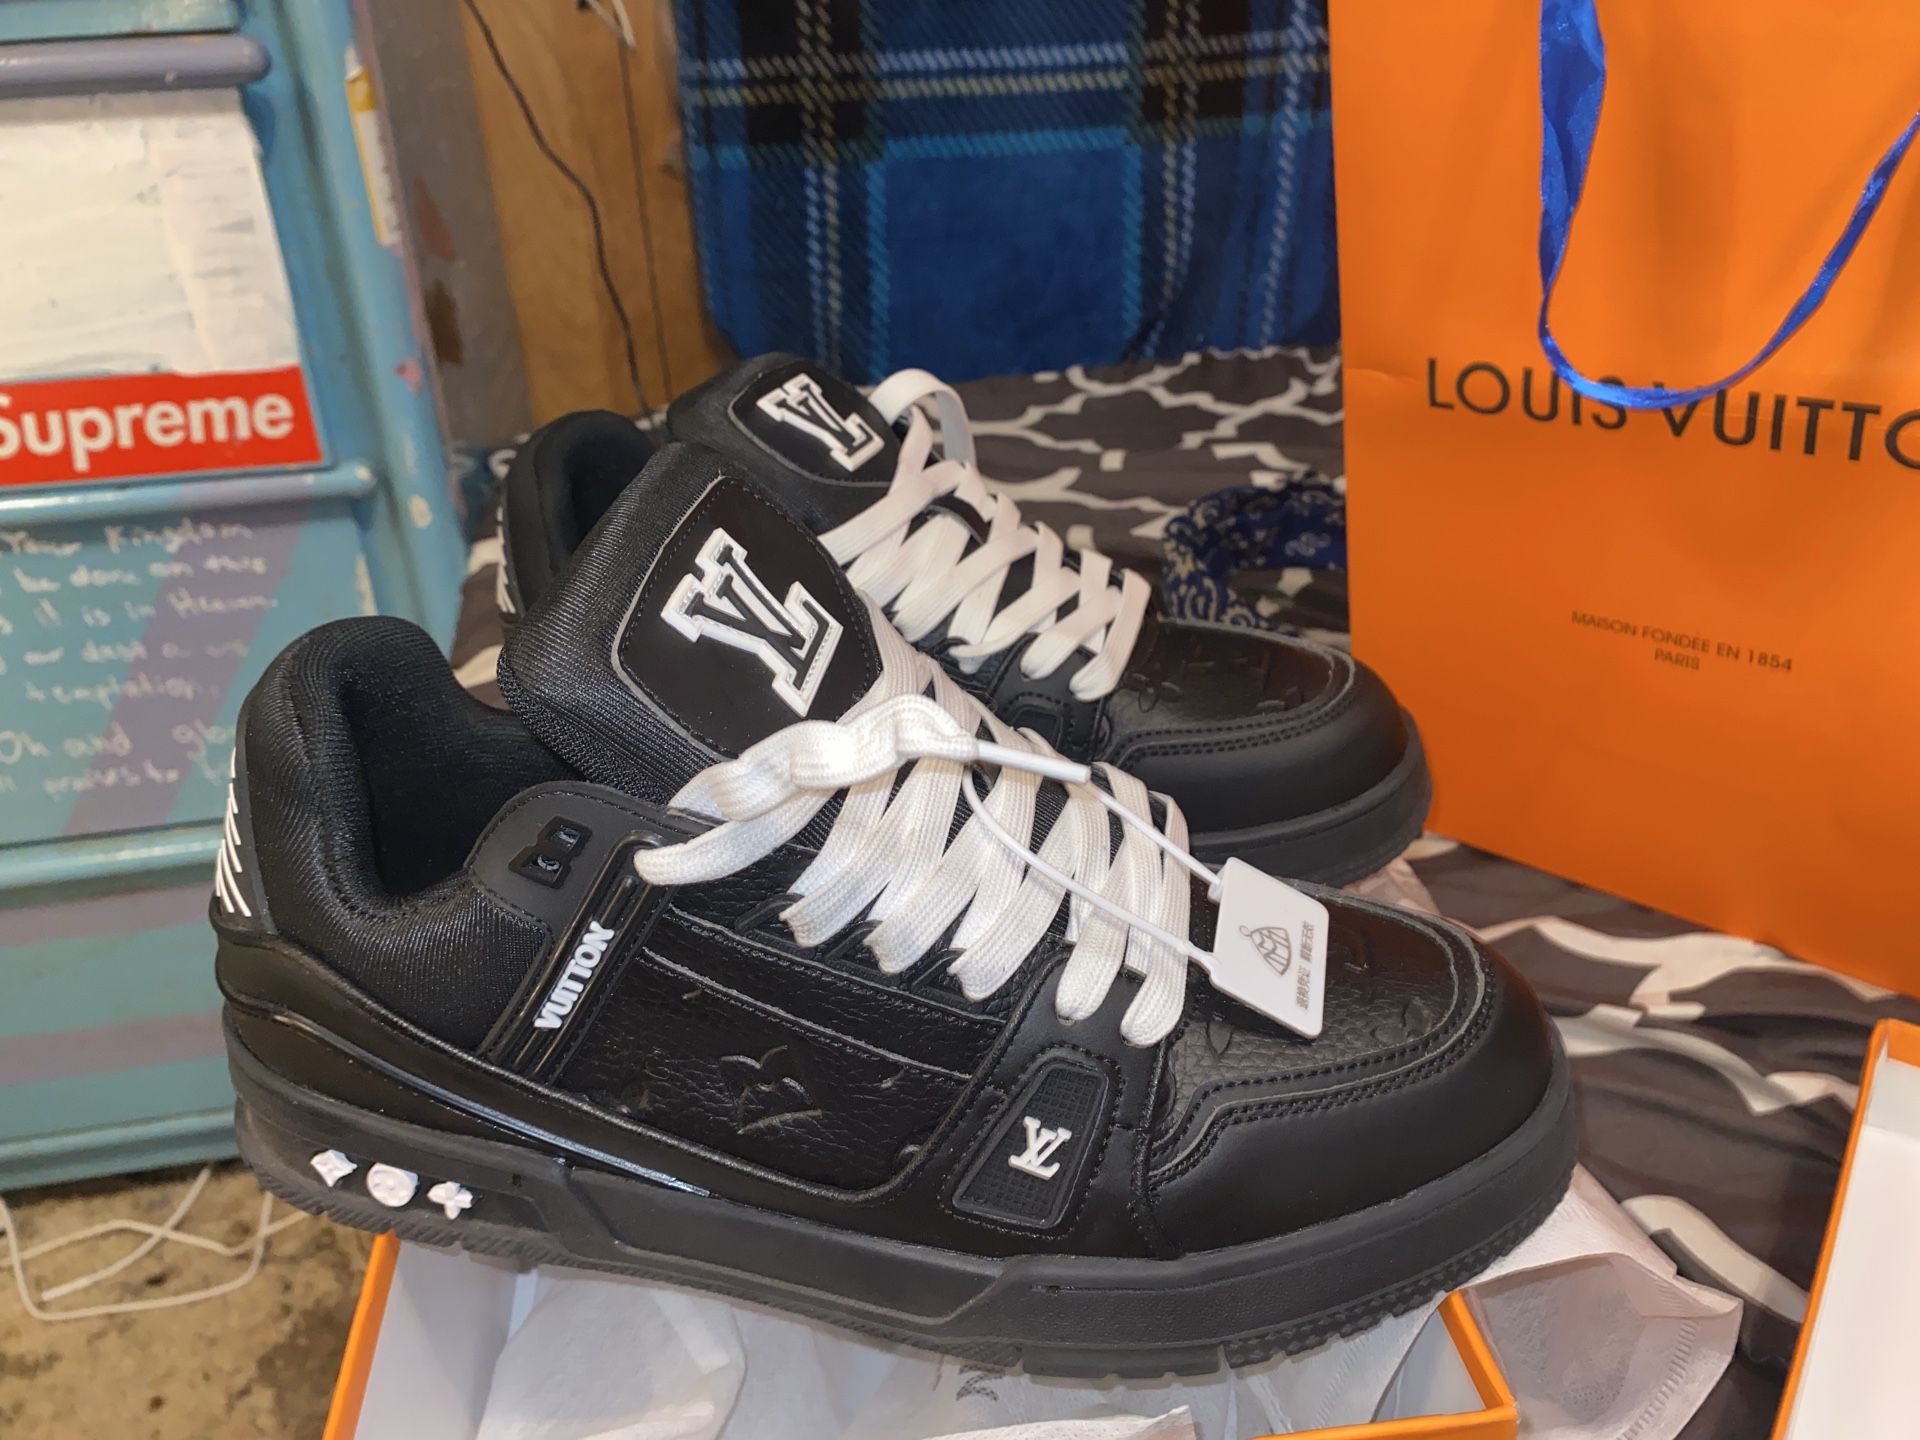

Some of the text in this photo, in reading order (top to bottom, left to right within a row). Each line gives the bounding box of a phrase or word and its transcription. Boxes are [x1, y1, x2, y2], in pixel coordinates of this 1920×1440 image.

[1571, 611, 1637, 637] MAISON
[1716, 641, 1741, 661] EN
[1748, 648, 1793, 672] 1854
[1654, 647, 1700, 671] PARIS
[533, 919, 615, 1030] VUITTON
[1007, 1115, 1073, 1181] LV
